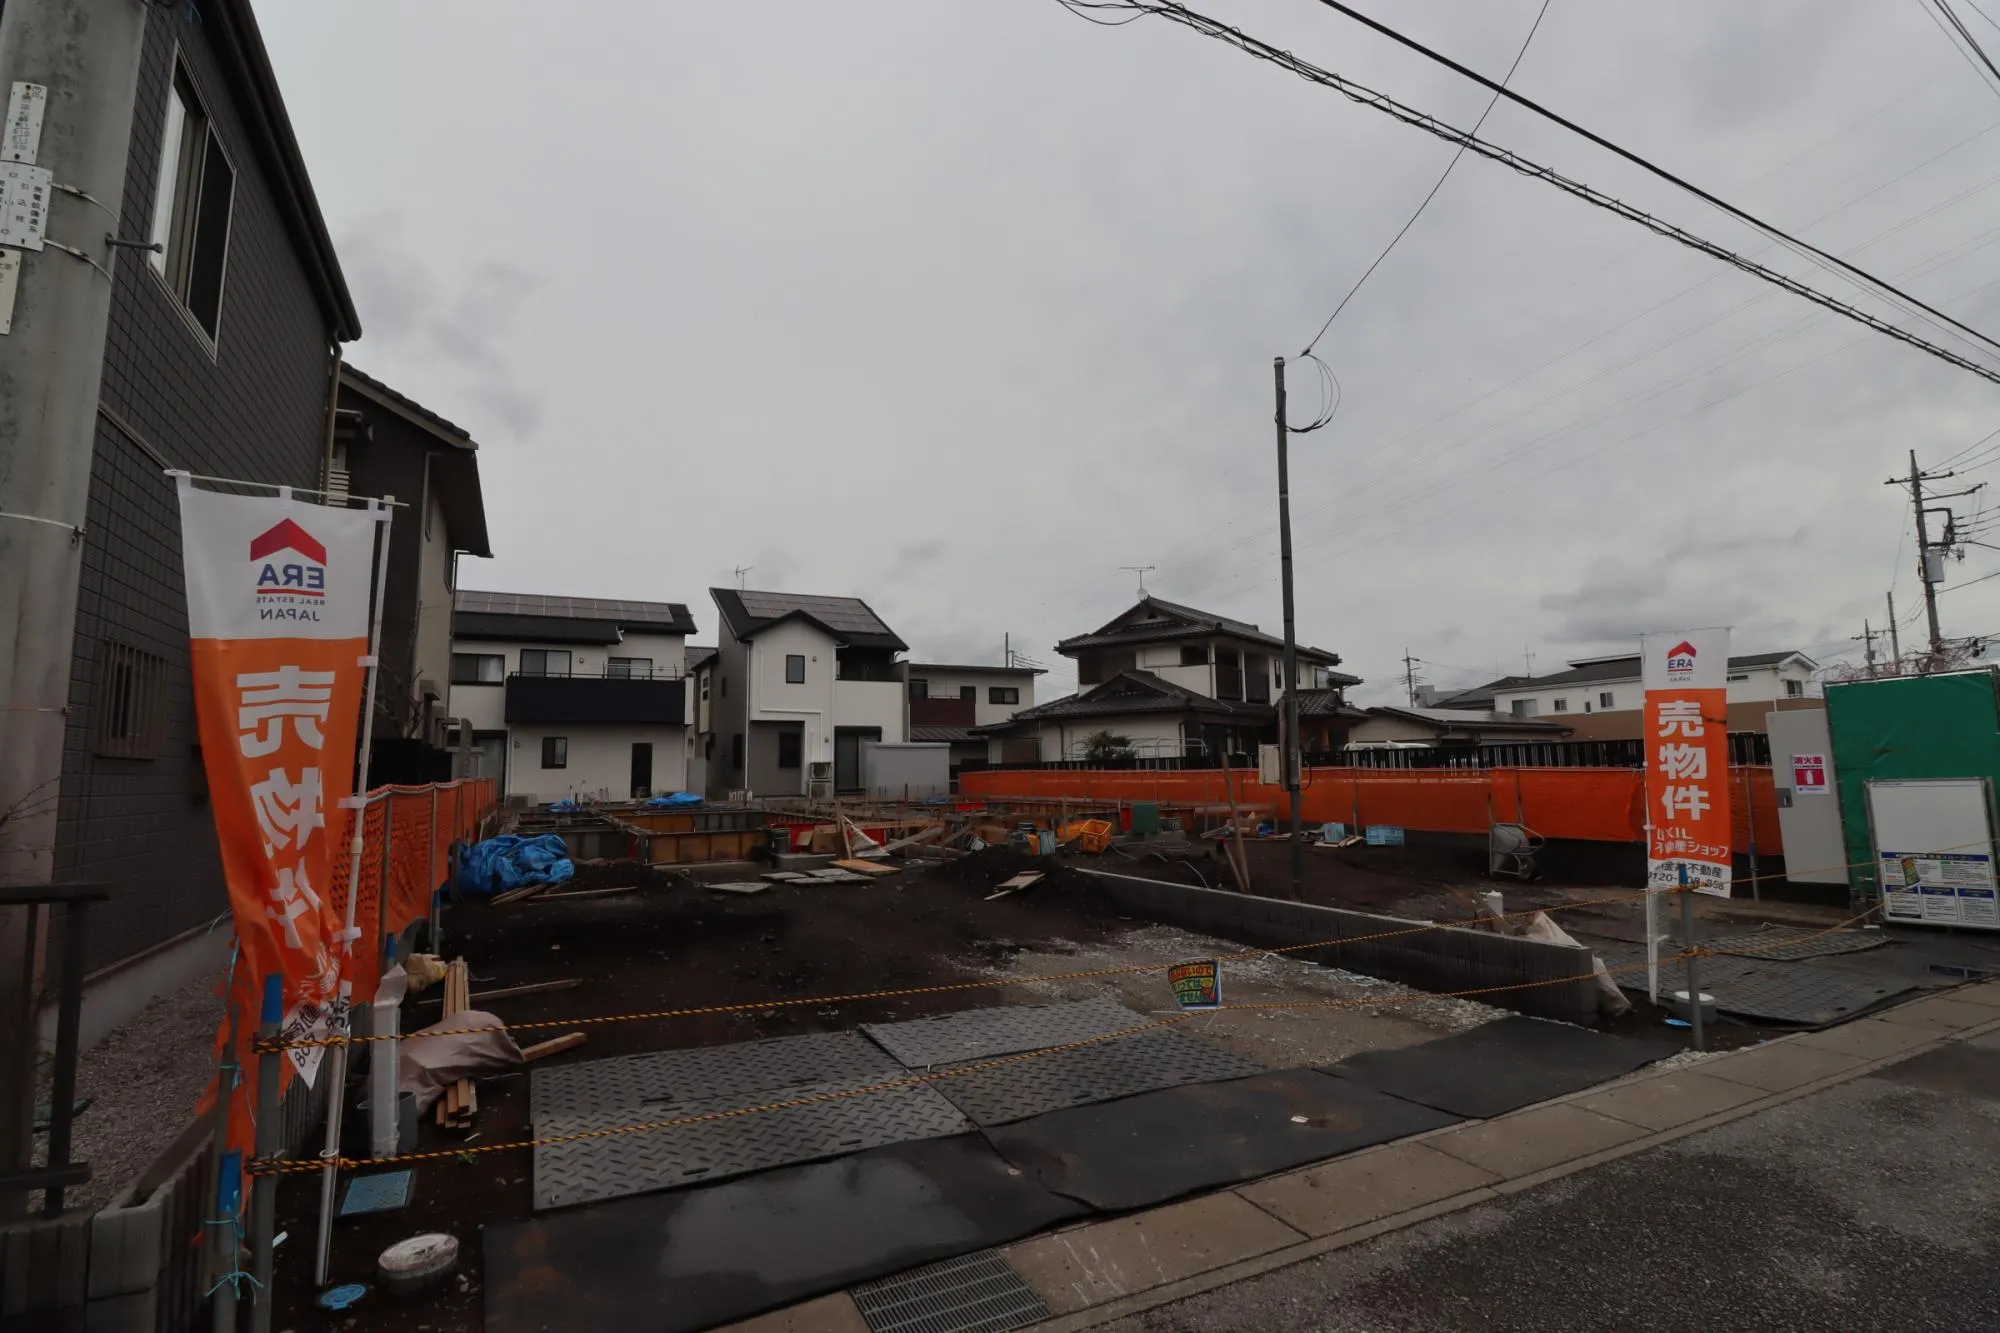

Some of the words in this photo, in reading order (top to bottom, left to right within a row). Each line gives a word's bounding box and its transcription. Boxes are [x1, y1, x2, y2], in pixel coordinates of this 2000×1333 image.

[1668, 659, 1693, 669] ERA
[1658, 699, 1711, 820] 売物件
[1794, 756, 1822, 764] 消火器
